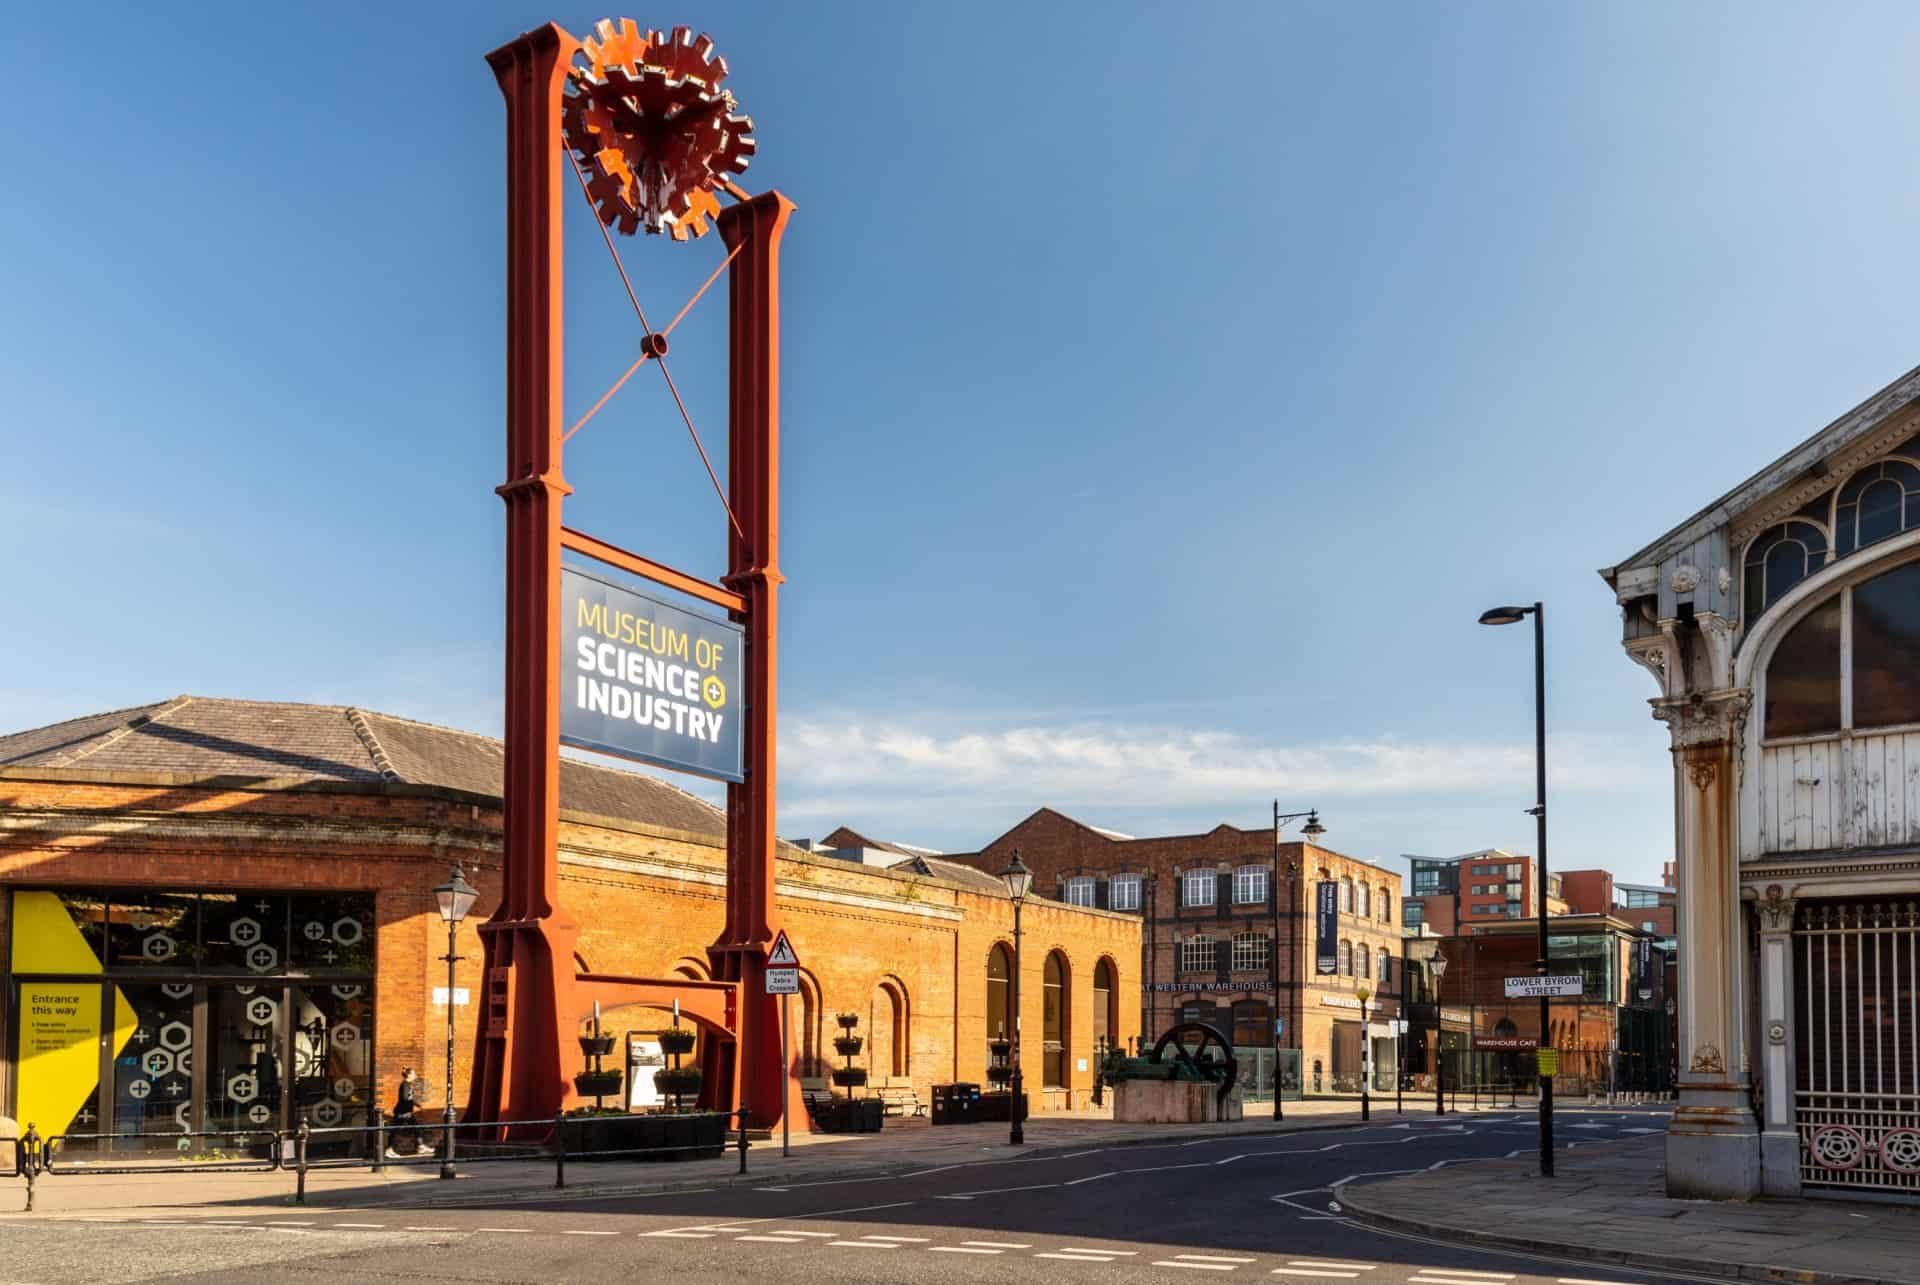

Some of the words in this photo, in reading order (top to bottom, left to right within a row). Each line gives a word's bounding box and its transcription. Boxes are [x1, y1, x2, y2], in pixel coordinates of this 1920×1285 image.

[577, 597, 688, 663] MUSEUM
[695, 638, 723, 671] OF
[577, 636, 700, 702] SCIENCE
[577, 675, 723, 743] INDUSTRY
[1506, 977, 1541, 986] LOWER
[1545, 976, 1580, 985] BYROM
[1155, 983, 1202, 992] WESTERN
[1207, 982, 1273, 992] WAREHOUSE
[1524, 987, 1561, 995] STREET
[32, 994, 79, 1004] Entrance
[32, 1006, 52, 1015] this
[56, 1007, 77, 1017] way
